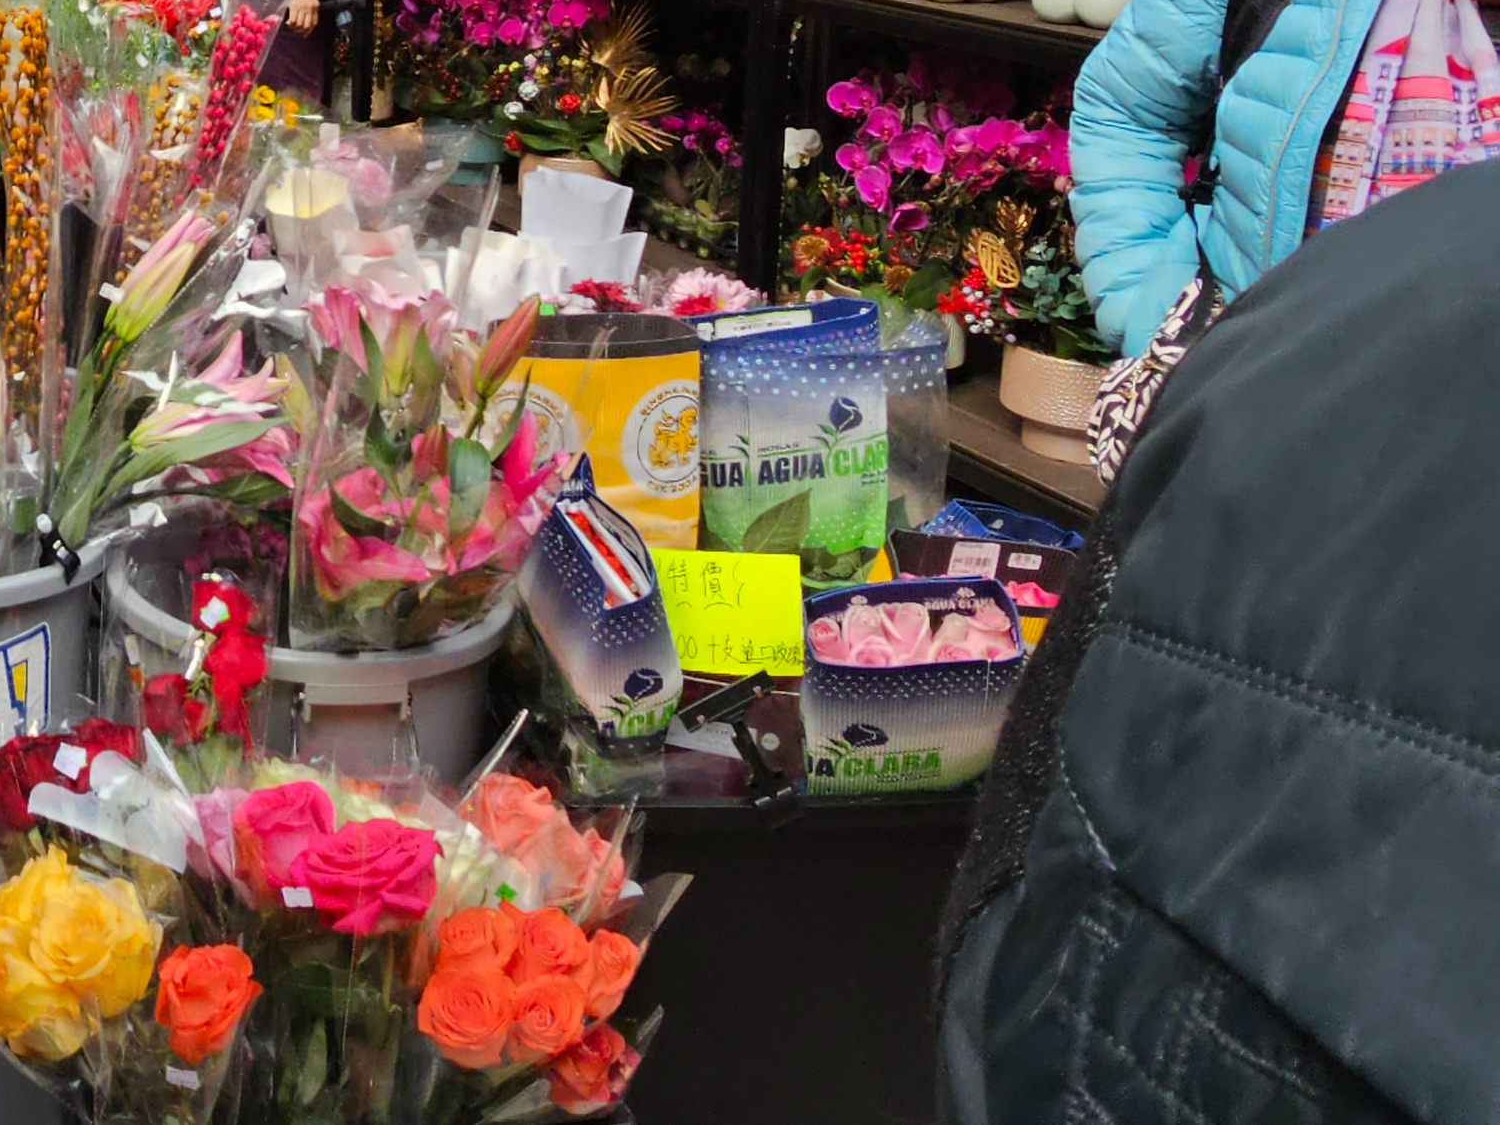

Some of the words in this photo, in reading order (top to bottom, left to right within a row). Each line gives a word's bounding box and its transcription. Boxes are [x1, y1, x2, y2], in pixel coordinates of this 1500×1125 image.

[699, 461, 744, 488] GUA
[758, 453, 825, 486] AGUA
[833, 440, 888, 477] CLAR
